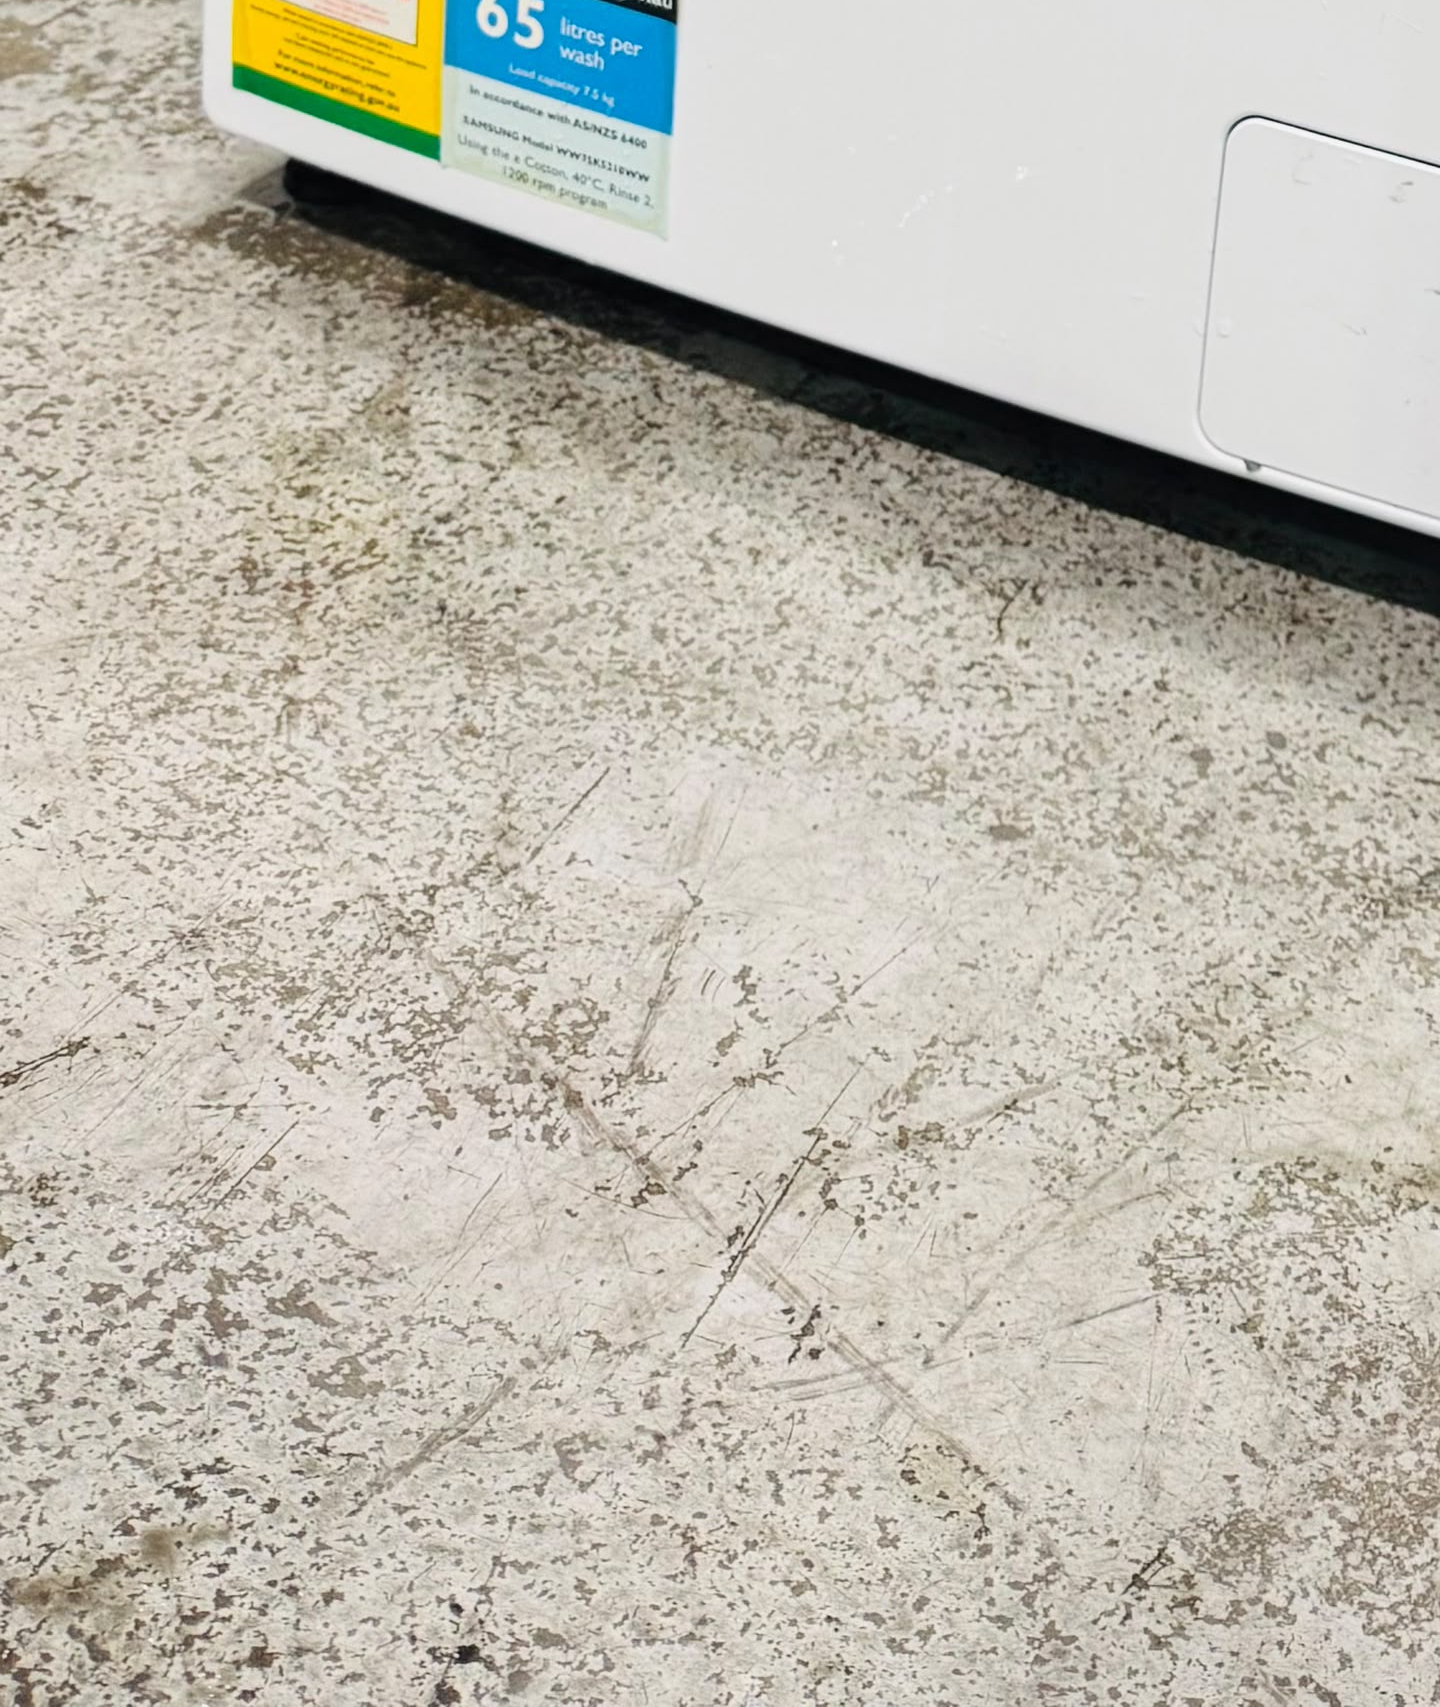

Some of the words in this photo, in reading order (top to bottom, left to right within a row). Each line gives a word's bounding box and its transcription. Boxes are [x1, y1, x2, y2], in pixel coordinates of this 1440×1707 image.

[560, 16, 605, 47] litres
[610, 36, 643, 57] per
[560, 45, 604, 71] wash
[470, 85, 480, 95] In
[548, 112, 571, 125] with
[462, 115, 520, 141] SAMSUNG
[457, 133, 488, 156] Using
[492, 146, 510, 161] the
[502, 166, 529, 184] 1200
[559, 186, 607, 210] program
